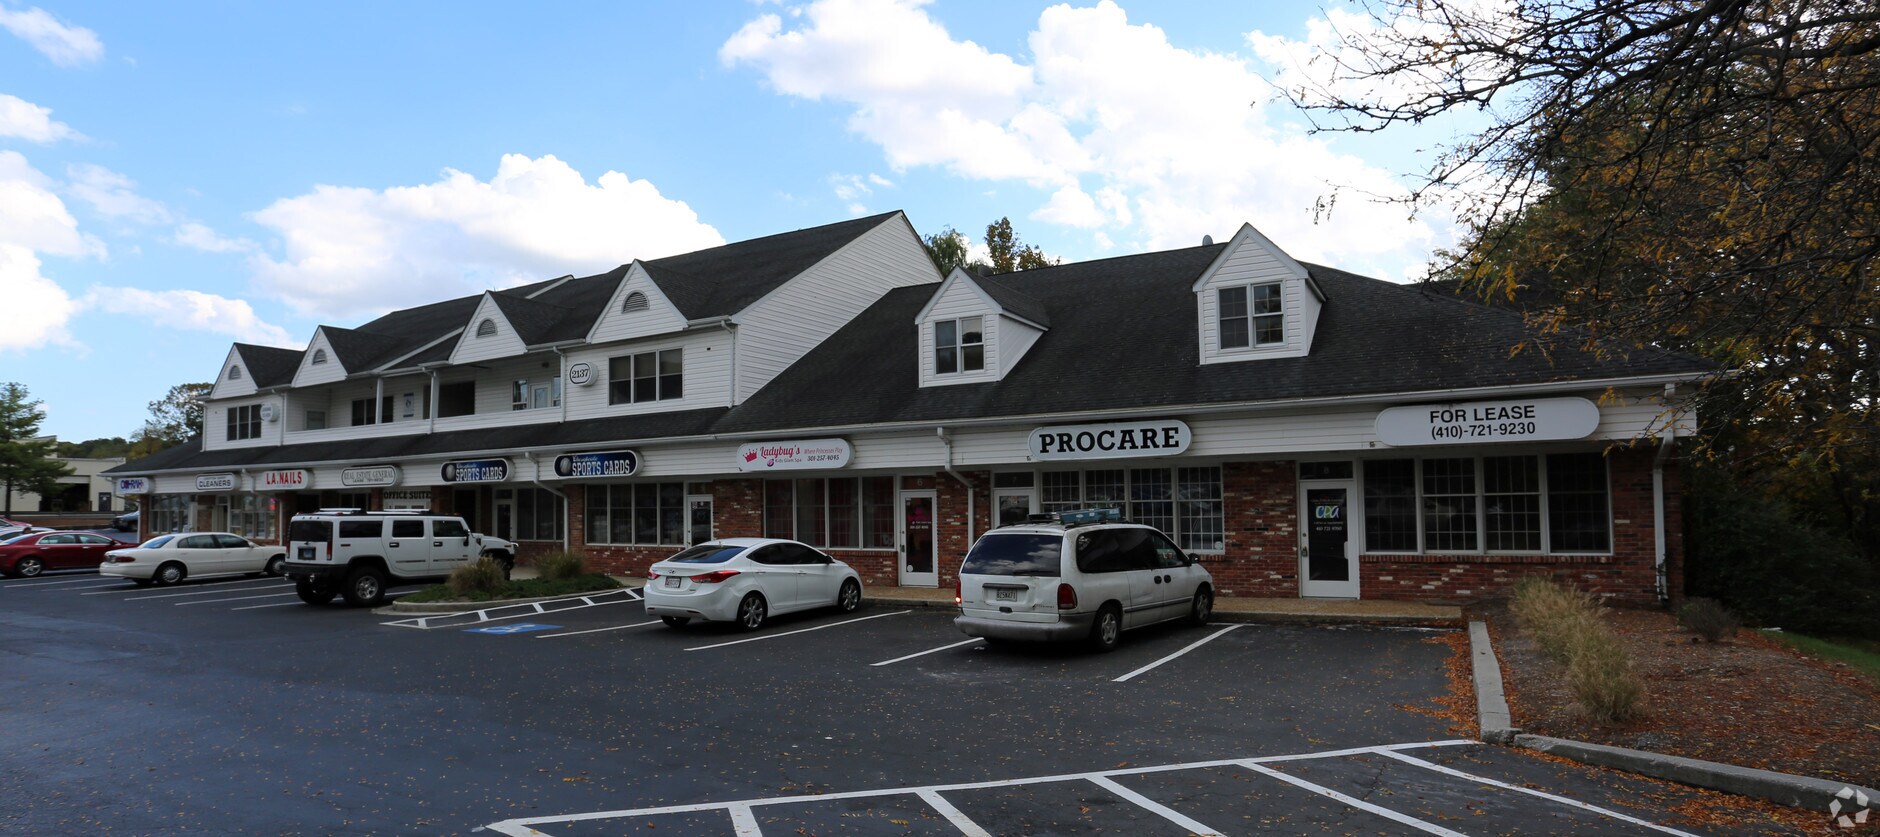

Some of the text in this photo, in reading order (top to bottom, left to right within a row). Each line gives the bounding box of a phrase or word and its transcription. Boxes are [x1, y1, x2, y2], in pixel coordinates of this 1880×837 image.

[572, 369, 589, 378] 2137
[1430, 405, 1535, 423] FOR LEASE
[1432, 422, 1536, 440] (410)-721-9230
[1039, 426, 1180, 454] PROCARE
[760, 444, 800, 459] Ladybug's
[456, 466, 503, 481] SPORTS CARDS
[572, 460, 630, 476] SPORTS CARDS
[384, 491, 407, 499] OFFICE
[1316, 505, 1339, 518] CPA
